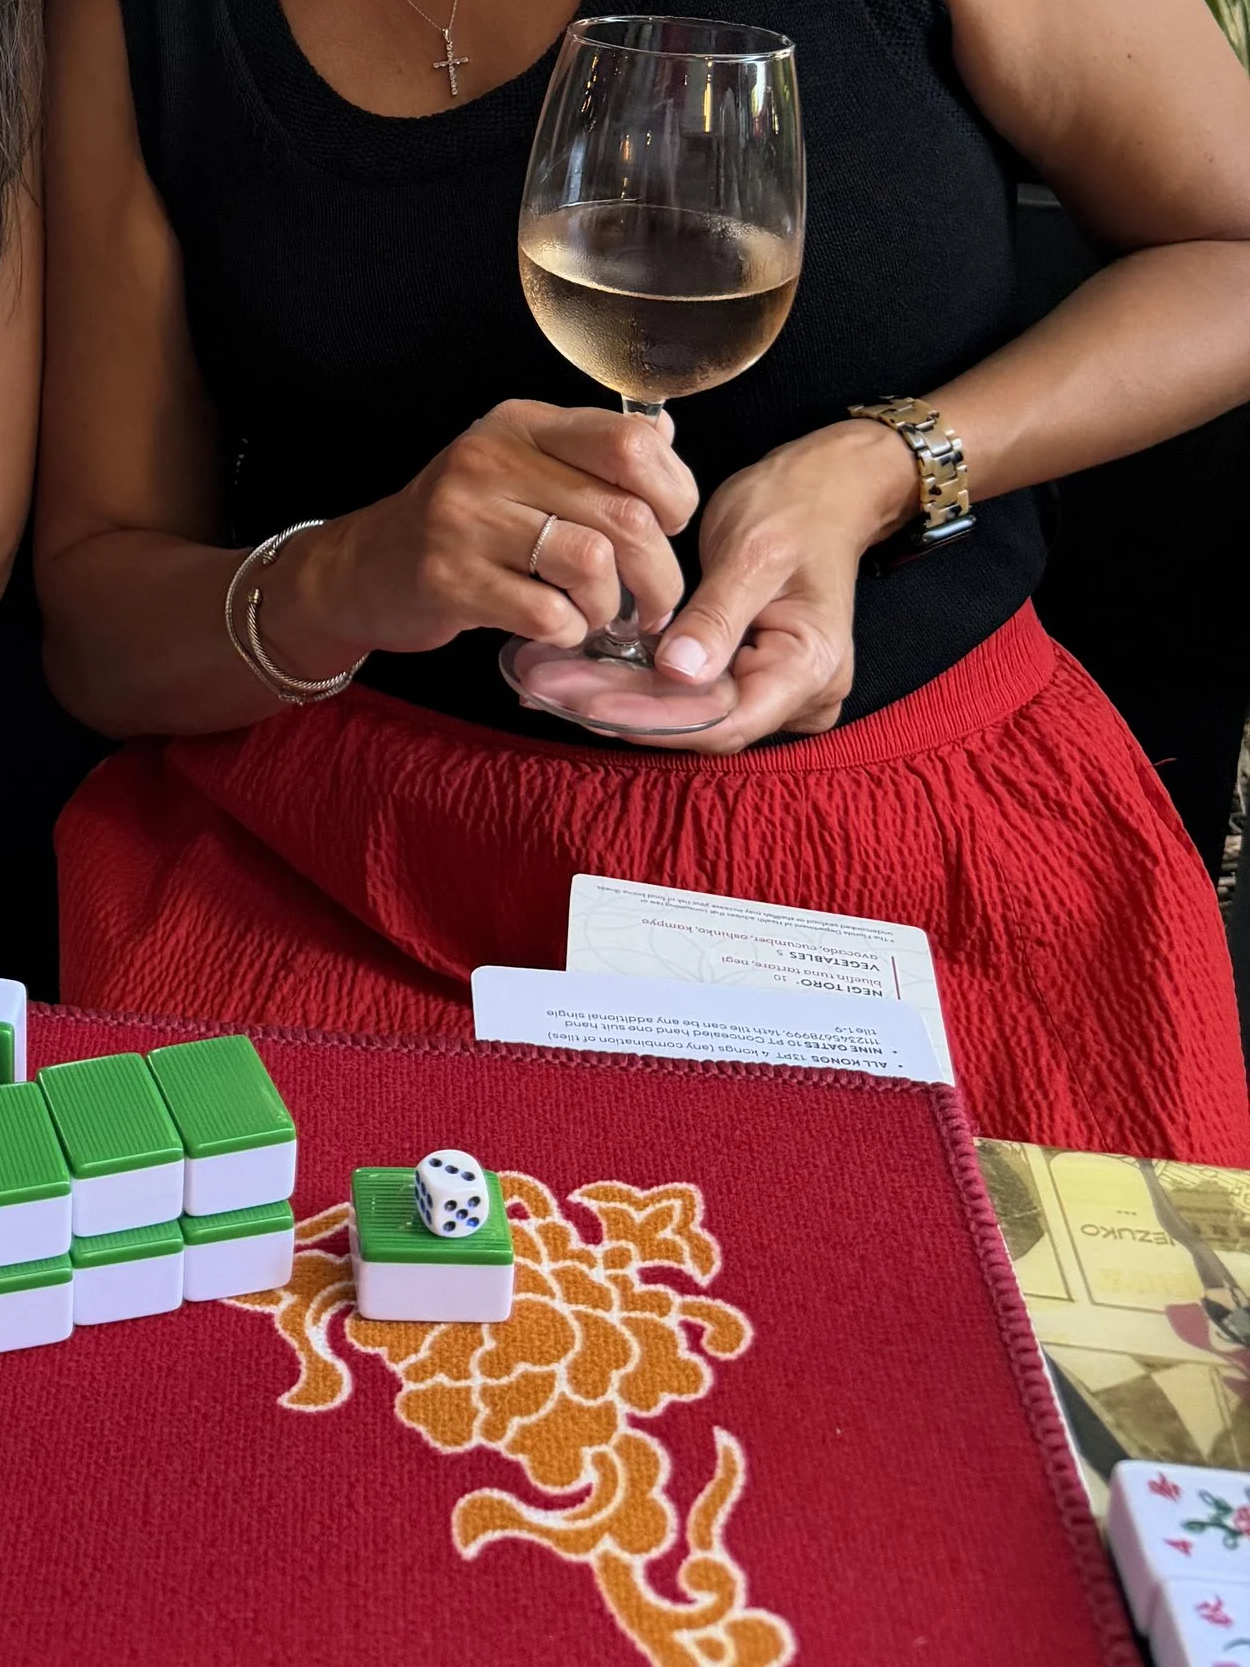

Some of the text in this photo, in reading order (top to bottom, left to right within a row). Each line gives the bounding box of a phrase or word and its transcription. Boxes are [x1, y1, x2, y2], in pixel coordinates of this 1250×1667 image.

[642, 919, 878, 961] avocado, cucumber, oshinko, kampyo
[790, 952, 879, 971] VEGETABLES
[722, 956, 881, 988] bluefin tuna tartare, negi
[774, 974, 786, 982] 10
[848, 986, 882, 997] NEGI
[546, 1009, 584, 1020] single
[588, 1013, 652, 1025] additional
[564, 1021, 598, 1030] hand
[656, 1017, 678, 1025] any
[682, 1020, 700, 1028] be
[600, 1023, 625, 1032] suit
[656, 1027, 690, 1036] hand
[730, 1025, 750, 1033] tile
[835, 1026, 876, 1036] tile 1-9
[548, 1032, 580, 1042] tiles)
[693, 1030, 764, 1044] Concealed
[599, 1037, 683, 1049] combination
[686, 1042, 714, 1052] (any
[718, 1045, 758, 1056] kongs
[850, 1045, 882, 1054] NINE
[862, 1060, 886, 1068] ALL
[1080, 1223, 1176, 1247] EZUKO
